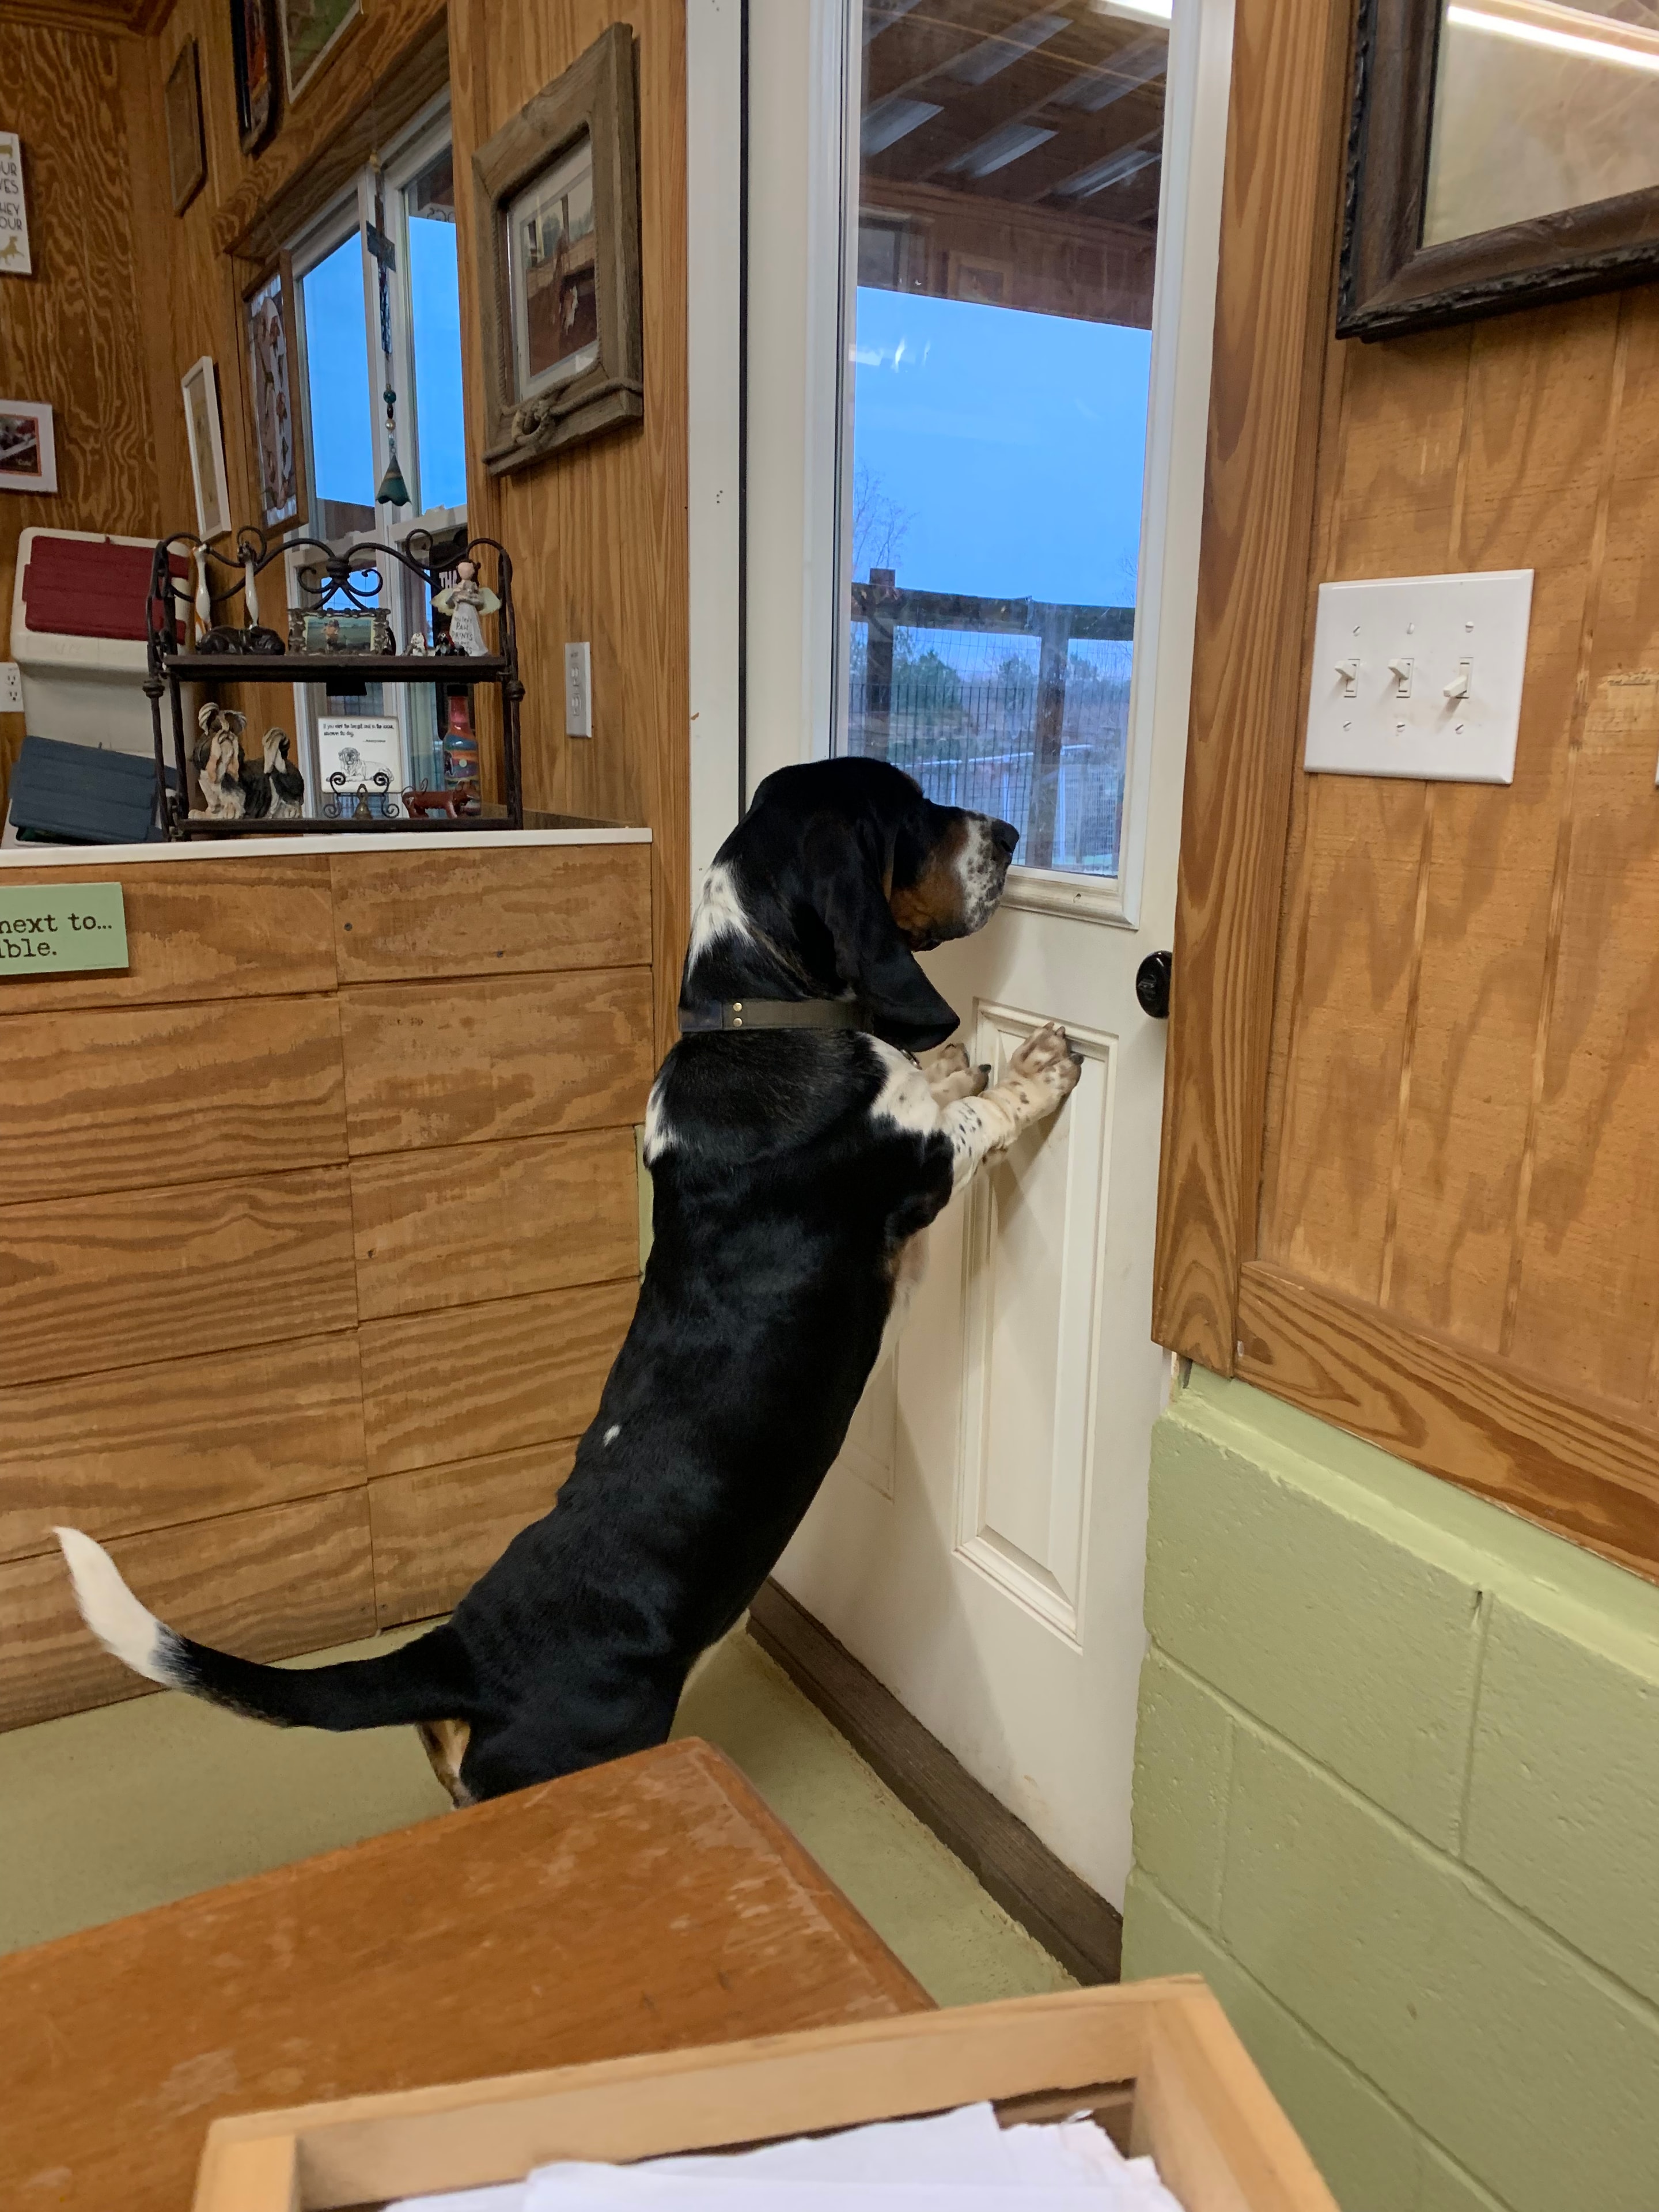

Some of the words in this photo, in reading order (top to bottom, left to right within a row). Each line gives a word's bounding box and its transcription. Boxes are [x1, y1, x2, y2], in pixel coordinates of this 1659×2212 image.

[0, 161, 17, 176] UR
[0, 914, 58, 933] next
[67, 913, 112, 930] to...
